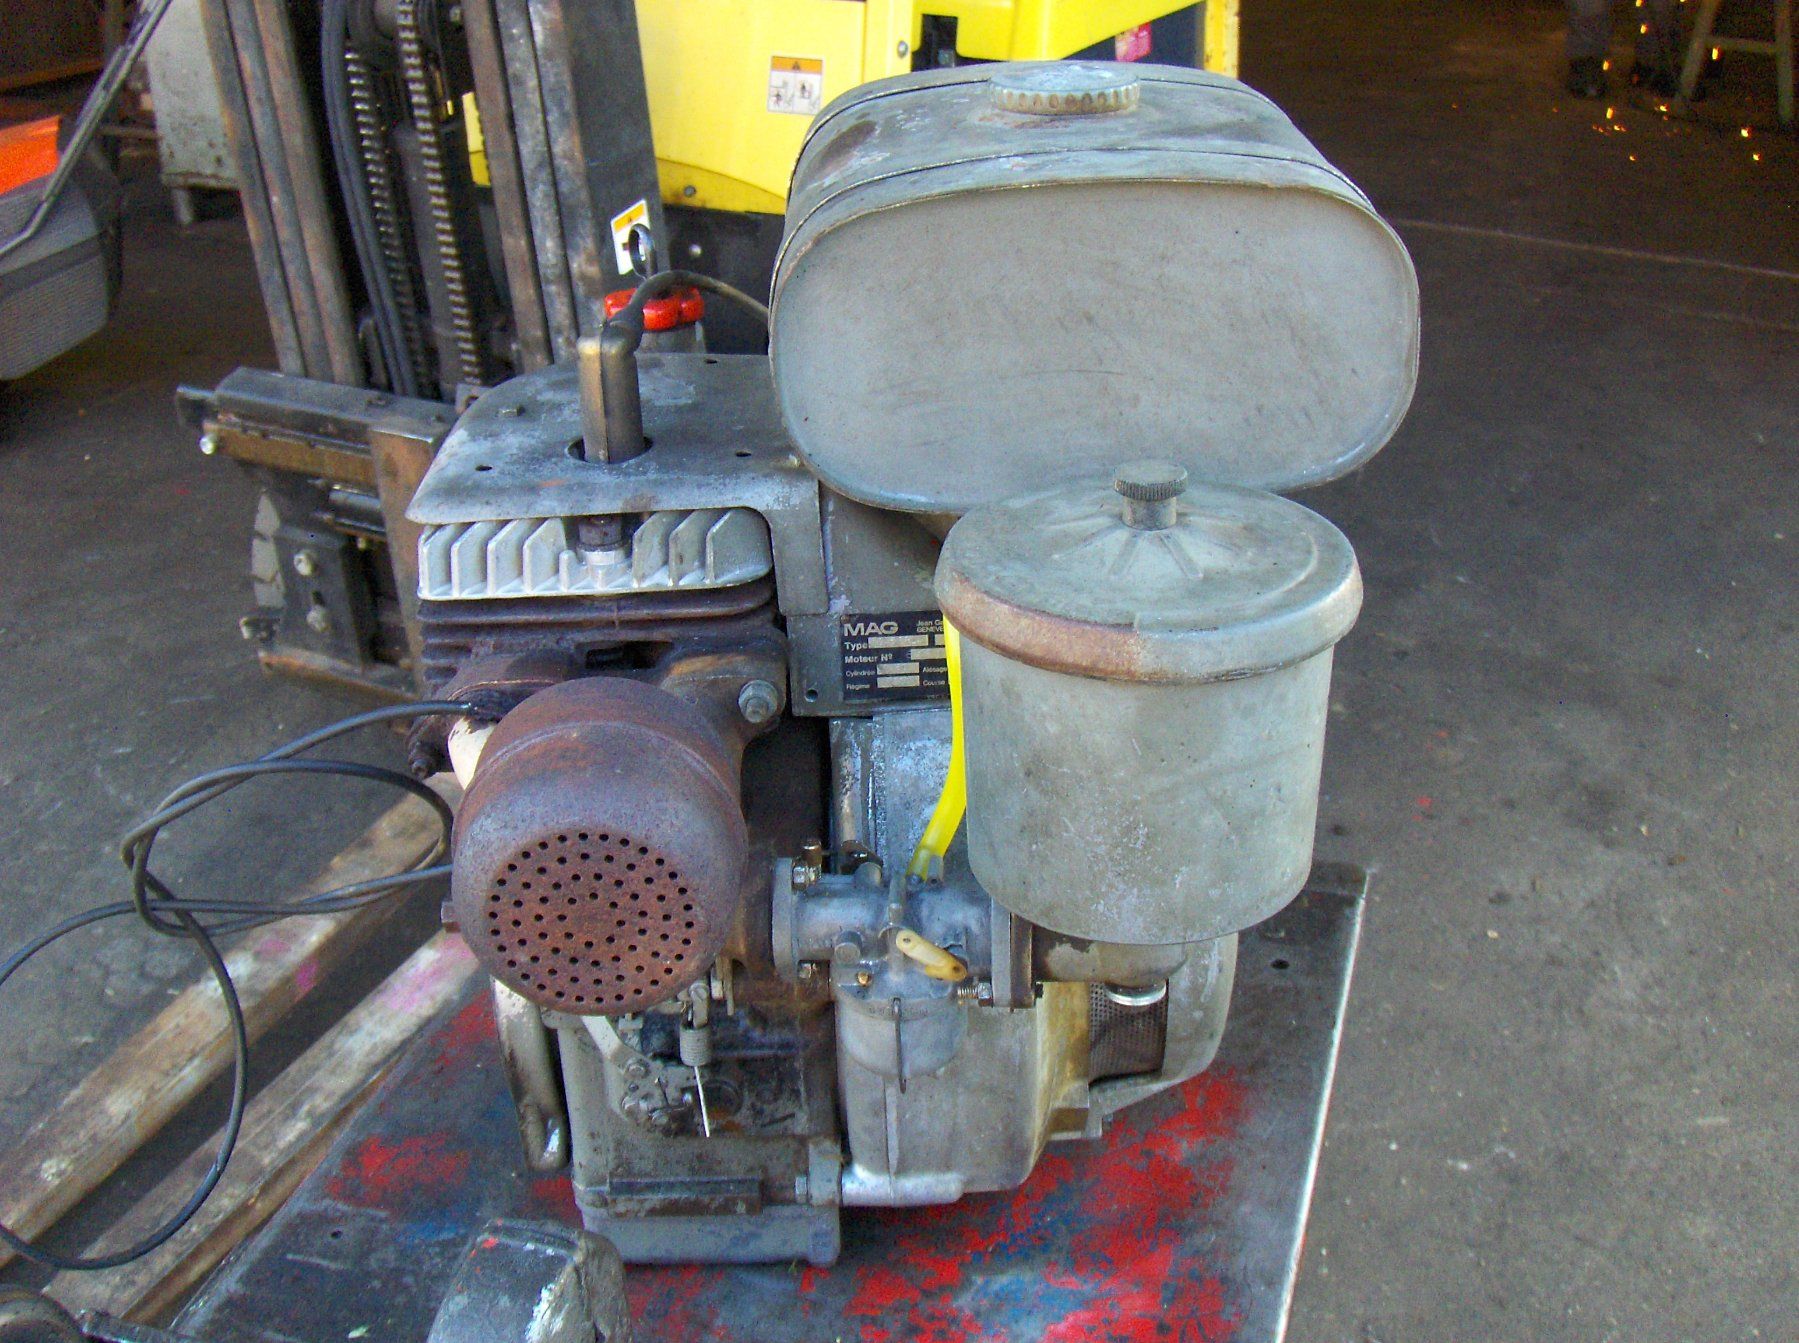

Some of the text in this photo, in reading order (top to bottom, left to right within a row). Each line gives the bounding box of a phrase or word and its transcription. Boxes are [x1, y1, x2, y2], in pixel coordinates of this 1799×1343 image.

[843, 621, 899, 637] MAG
[844, 641, 868, 651] Type
[844, 655, 878, 664] Moteur
